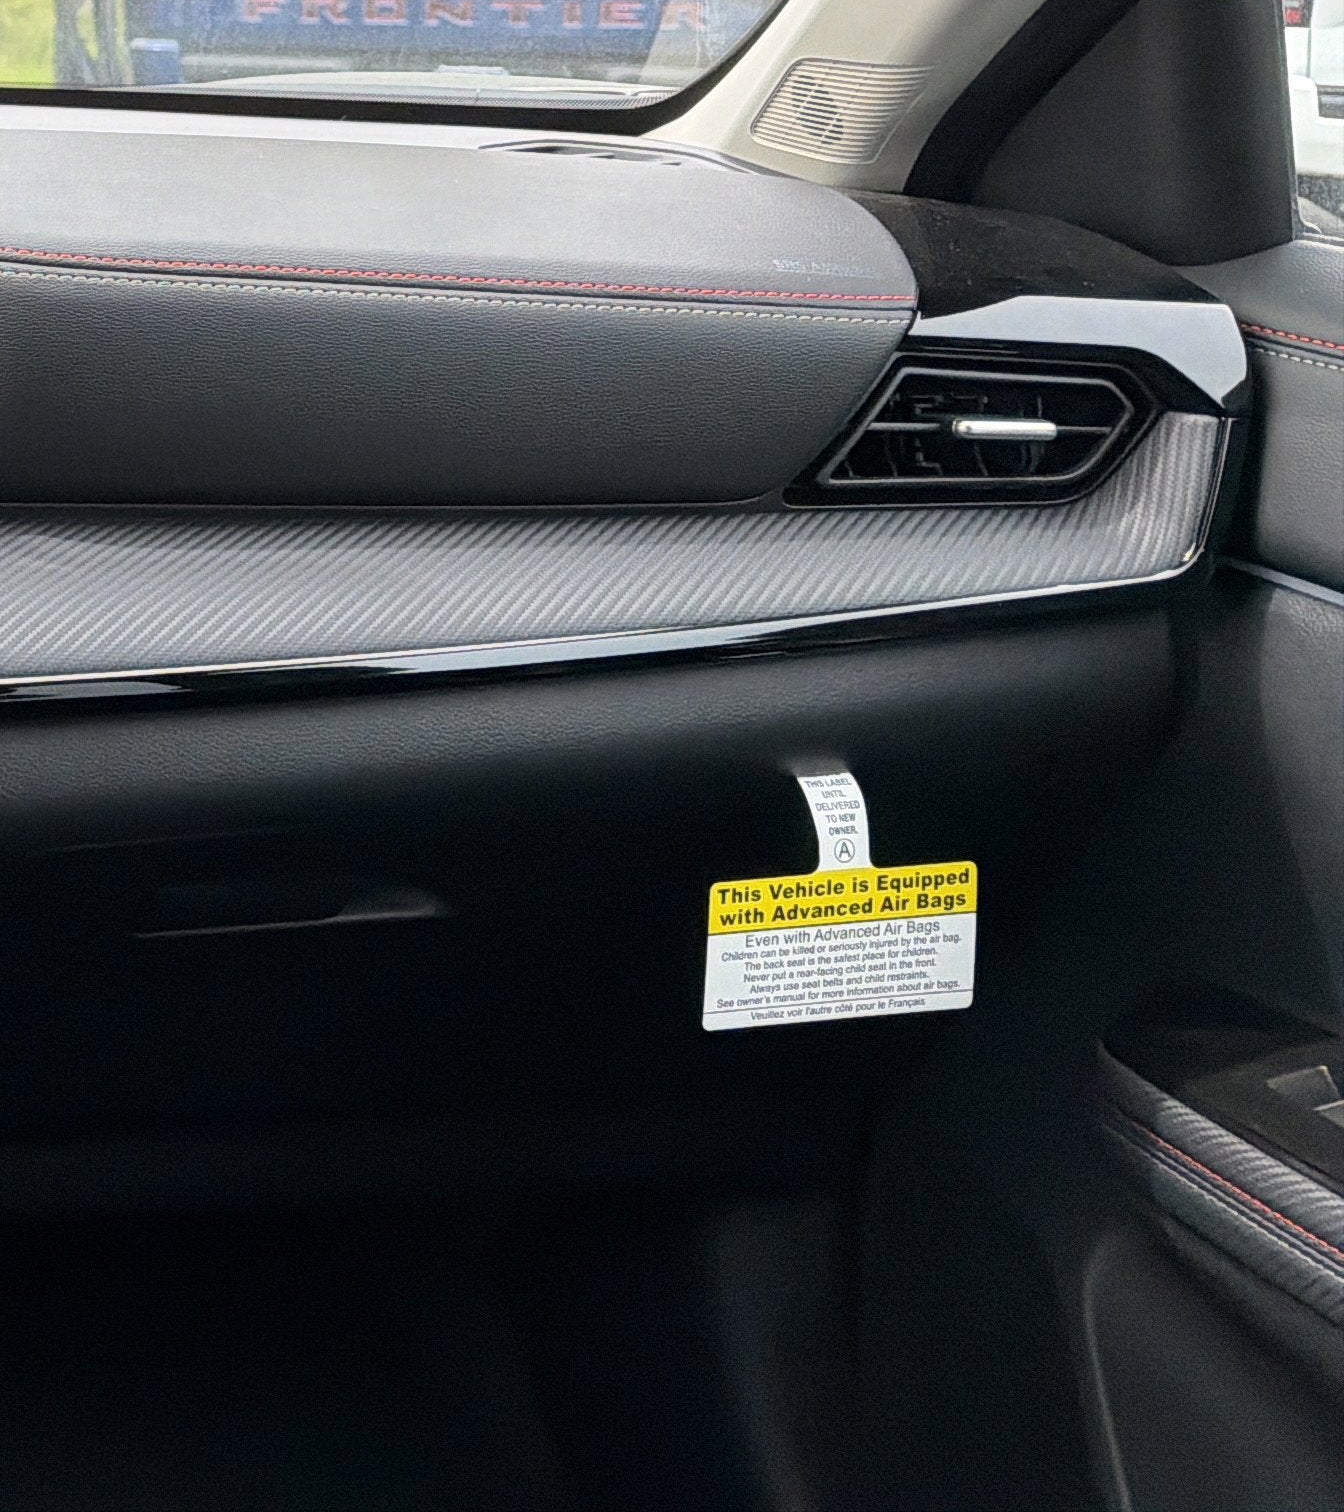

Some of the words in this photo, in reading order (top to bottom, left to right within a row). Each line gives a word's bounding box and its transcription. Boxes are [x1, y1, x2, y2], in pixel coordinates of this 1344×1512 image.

[821, 789, 847, 799] UNTIL
[825, 777, 852, 787] LABEL
[815, 800, 861, 811] DELIVERED
[825, 814, 837, 823] TO
[839, 813, 856, 823] NEW
[838, 841, 852, 859] A
[717, 885, 762, 905] This
[769, 878, 845, 901] Vehicle
[852, 876, 869, 893] is
[876, 868, 971, 892] Equipped
[719, 905, 765, 926] with
[771, 898, 873, 923] Advanced
[880, 895, 910, 912] Air
[916, 892, 967, 911] Bags
[745, 934, 780, 948] Even
[784, 930, 811, 944] with
[814, 925, 881, 942] Advanced
[883, 922, 903, 937] Air
[906, 920, 941, 936] Bags
[721, 951, 759, 962] Children
[760, 950, 777, 959] can
[779, 948, 790, 957] be
[793, 945, 815, 955] killed
[817, 944, 826, 953] or
[828, 941, 868, 952] seriously
[869, 938, 898, 949] injured
[901, 936, 911, 947] by
[913, 935, 927, 944] the
[929, 934, 940, 943] air
[943, 933, 962, 944] bag.
[744, 961, 762, 971] The
[763, 959, 784, 970] back
[787, 958, 806, 967] seat
[808, 957, 815, 965] is
[817, 955, 832, 965] the
[834, 953, 860, 963] safest
[861, 951, 885, 962] place
[887, 949, 900, 958] for
[902, 947, 938, 958] children.
[744, 973, 769, 983] Never
[772, 971, 787, 982] put
[796, 967, 844, 978] rear-facing
[845, 964, 866, 974] child
[867, 962, 887, 971] seat
[889, 961, 897, 970] in
[899, 959, 913, 969] the
[716, 999, 734, 1008] See
[736, 995, 771, 1007] owner's
[773, 992, 806, 1003] manual
[807, 990, 820, 999] for
[821, 989, 845, 999] more
[846, 984, 895, 996] information
[896, 982, 922, 992] about
[923, 980, 935, 989] air
[936, 979, 961, 990] bags.
[750, 983, 781, 994] Always
[783, 982, 800, 991] use
[801, 979, 820, 989] seat
[823, 977, 843, 987] belts
[846, 975, 863, 985] and
[864, 973, 885, 983] child
[750, 1010, 785, 1021] Veuillez
[787, 1008, 803, 1018] voir
[805, 1005, 832, 1016] l'autre
[834, 1003, 853, 1013] côté
[855, 1002, 876, 1012] pour
[877, 1000, 886, 1009] le
[887, 997, 926, 1009] Français
